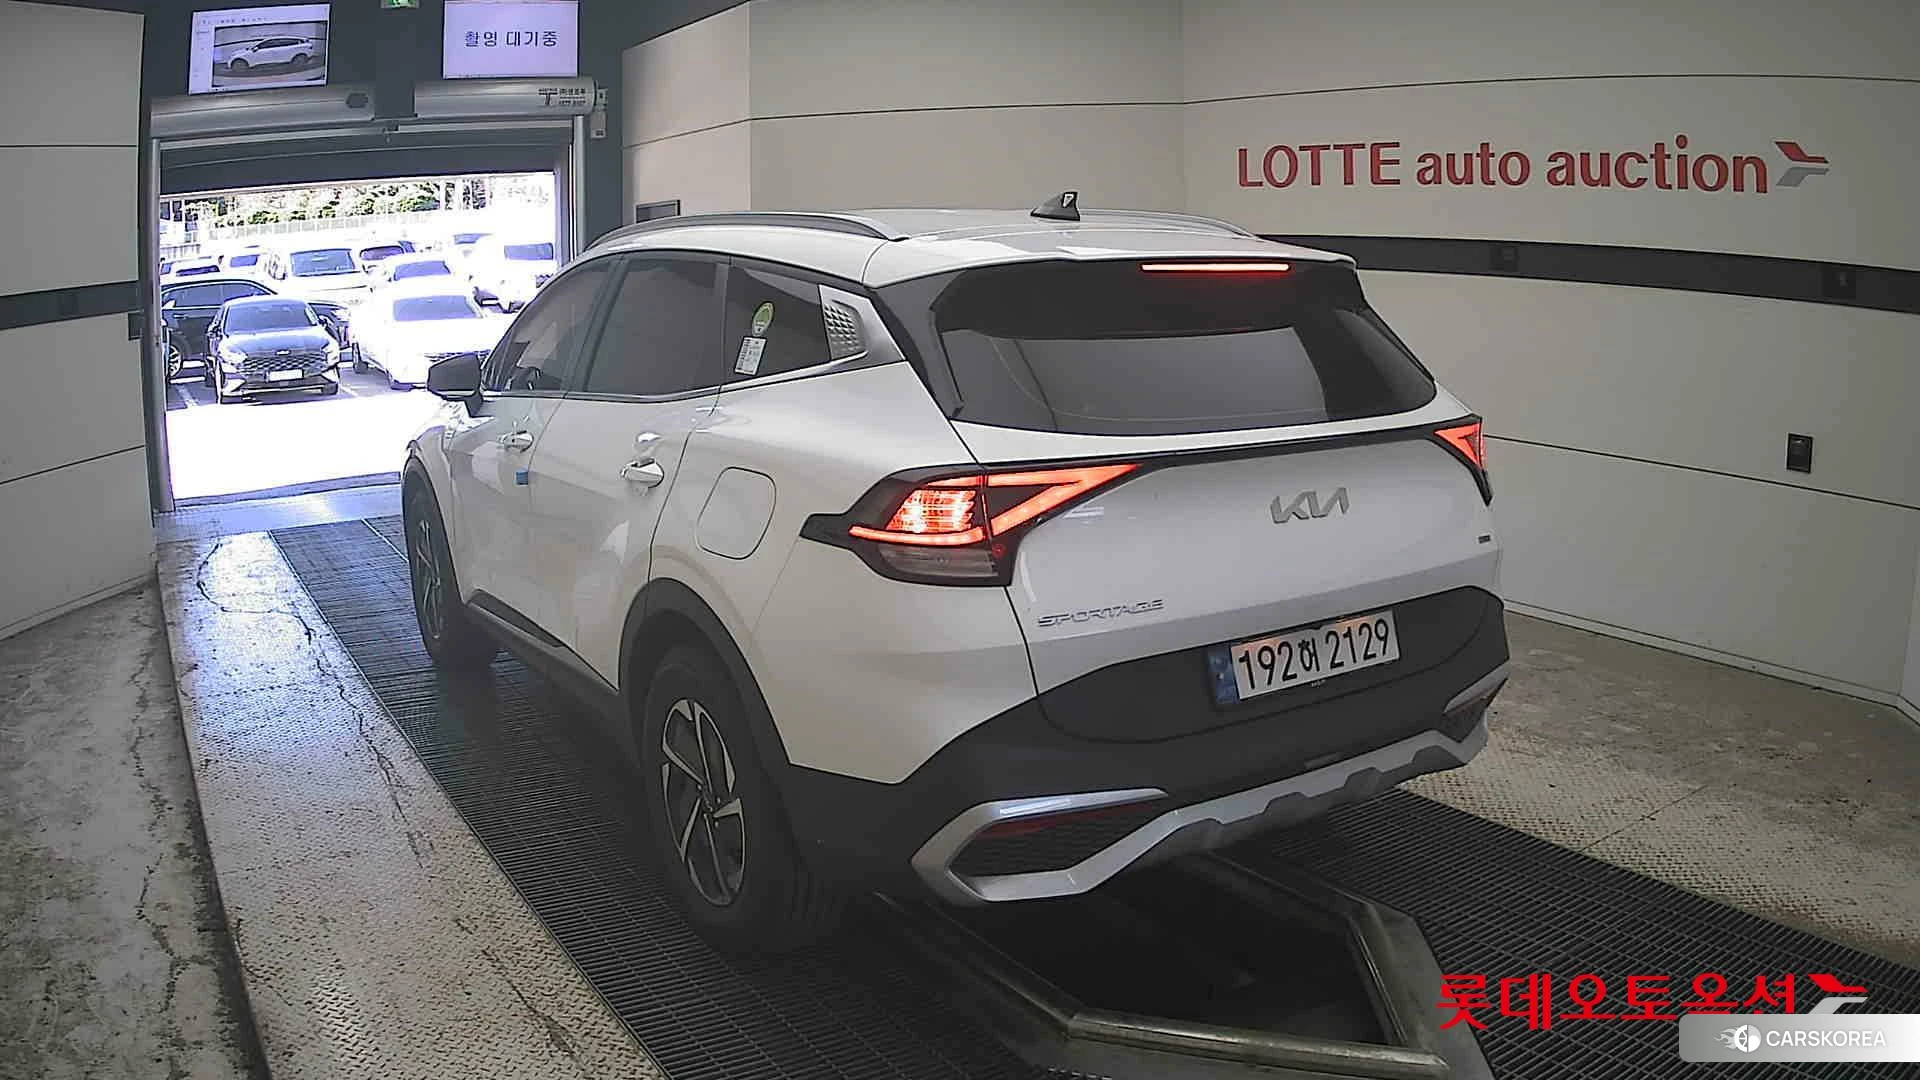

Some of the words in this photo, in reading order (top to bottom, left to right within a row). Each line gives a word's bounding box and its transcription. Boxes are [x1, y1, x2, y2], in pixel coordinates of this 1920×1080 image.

[465, 31, 498, 48] 촬영
[505, 31, 558, 48] 대기중
[1237, 142, 1400, 189] LOTTE
[1416, 142, 1532, 186] auto
[1546, 134, 1769, 194] auction
[1270, 487, 1350, 524] KIA
[1037, 598, 1165, 628] SPORTAGE
[1325, 618, 1390, 670] 2129
